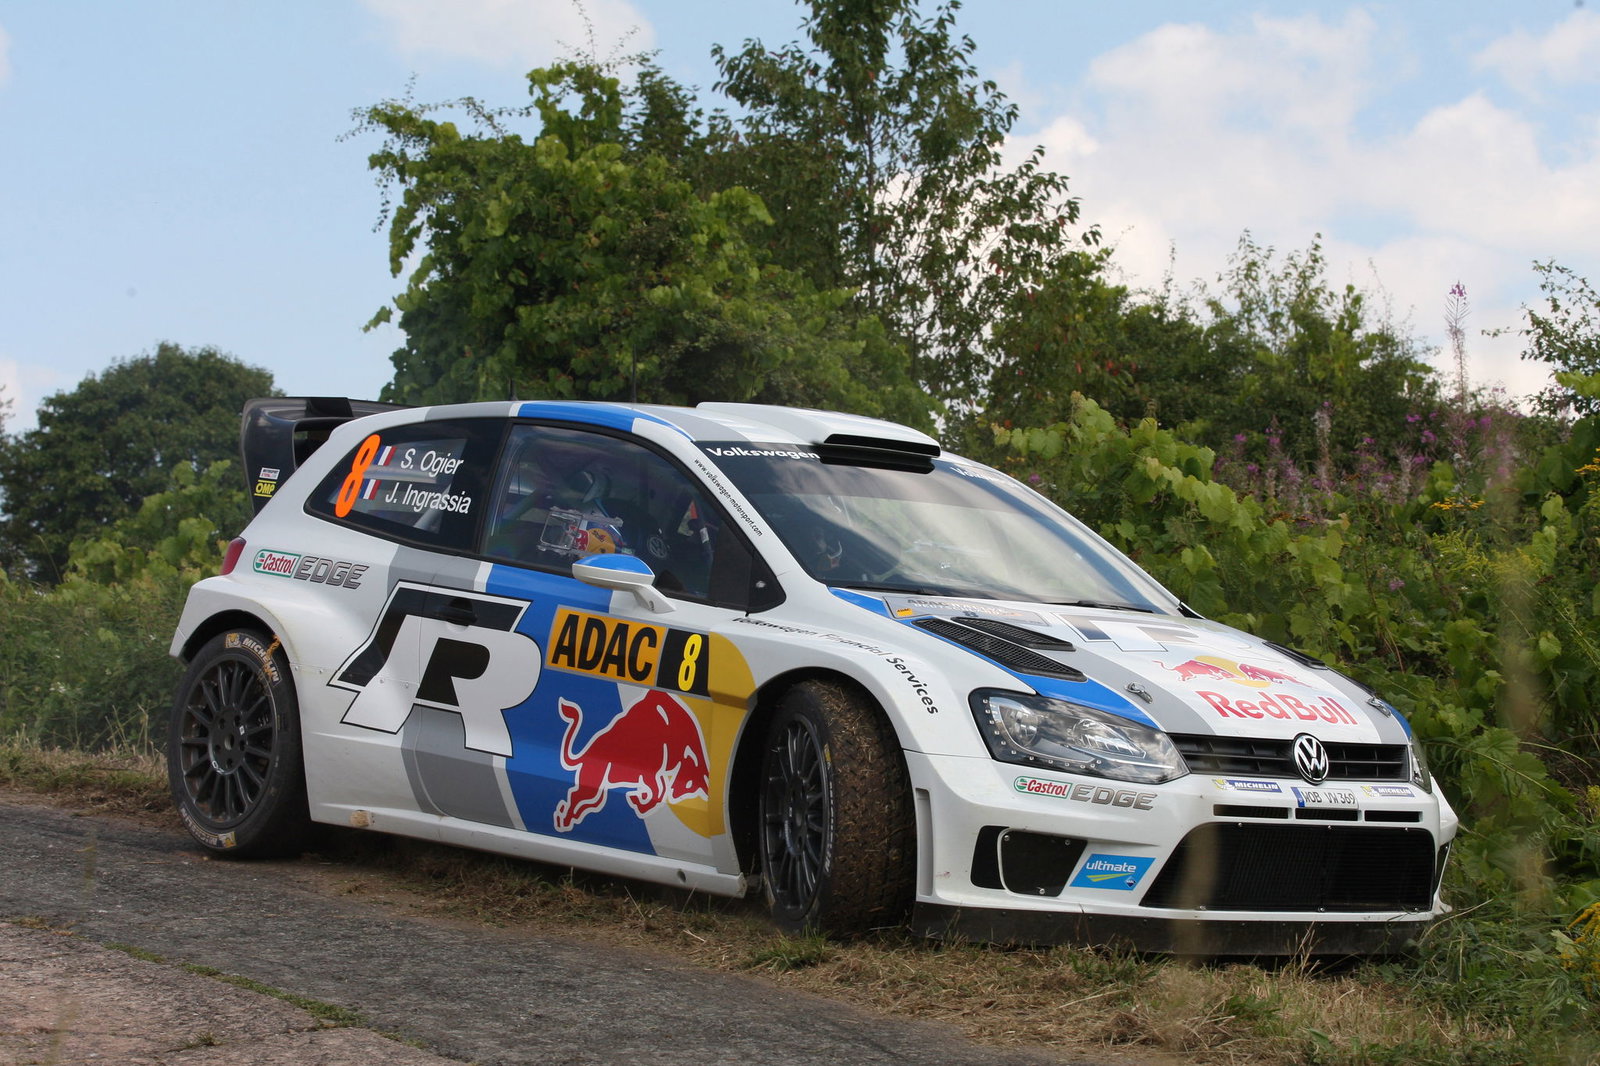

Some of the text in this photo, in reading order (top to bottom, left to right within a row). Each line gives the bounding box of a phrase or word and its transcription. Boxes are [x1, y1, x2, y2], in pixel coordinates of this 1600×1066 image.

[400, 448, 465, 475] S. Ogier
[706, 447, 821, 460] Volkswagen
[255, 482, 276, 495] OMP
[335, 434, 381, 518] 8
[385, 482, 472, 514] J. Ingrassia
[694, 459, 763, 537] www.volkswagen-motorsport.com
[262, 553, 370, 590] Castrol EDGE
[551, 613, 658, 682] ADAC
[677, 633, 703, 692] 8
[732, 617, 939, 715] Volkswagen Financial Services
[1026, 779, 1158, 811] Castrol EDGE
[1234, 781, 1279, 790] MICHELIN
[1301, 790, 1322, 803] WOB
[1085, 860, 1137, 873] ultimate
